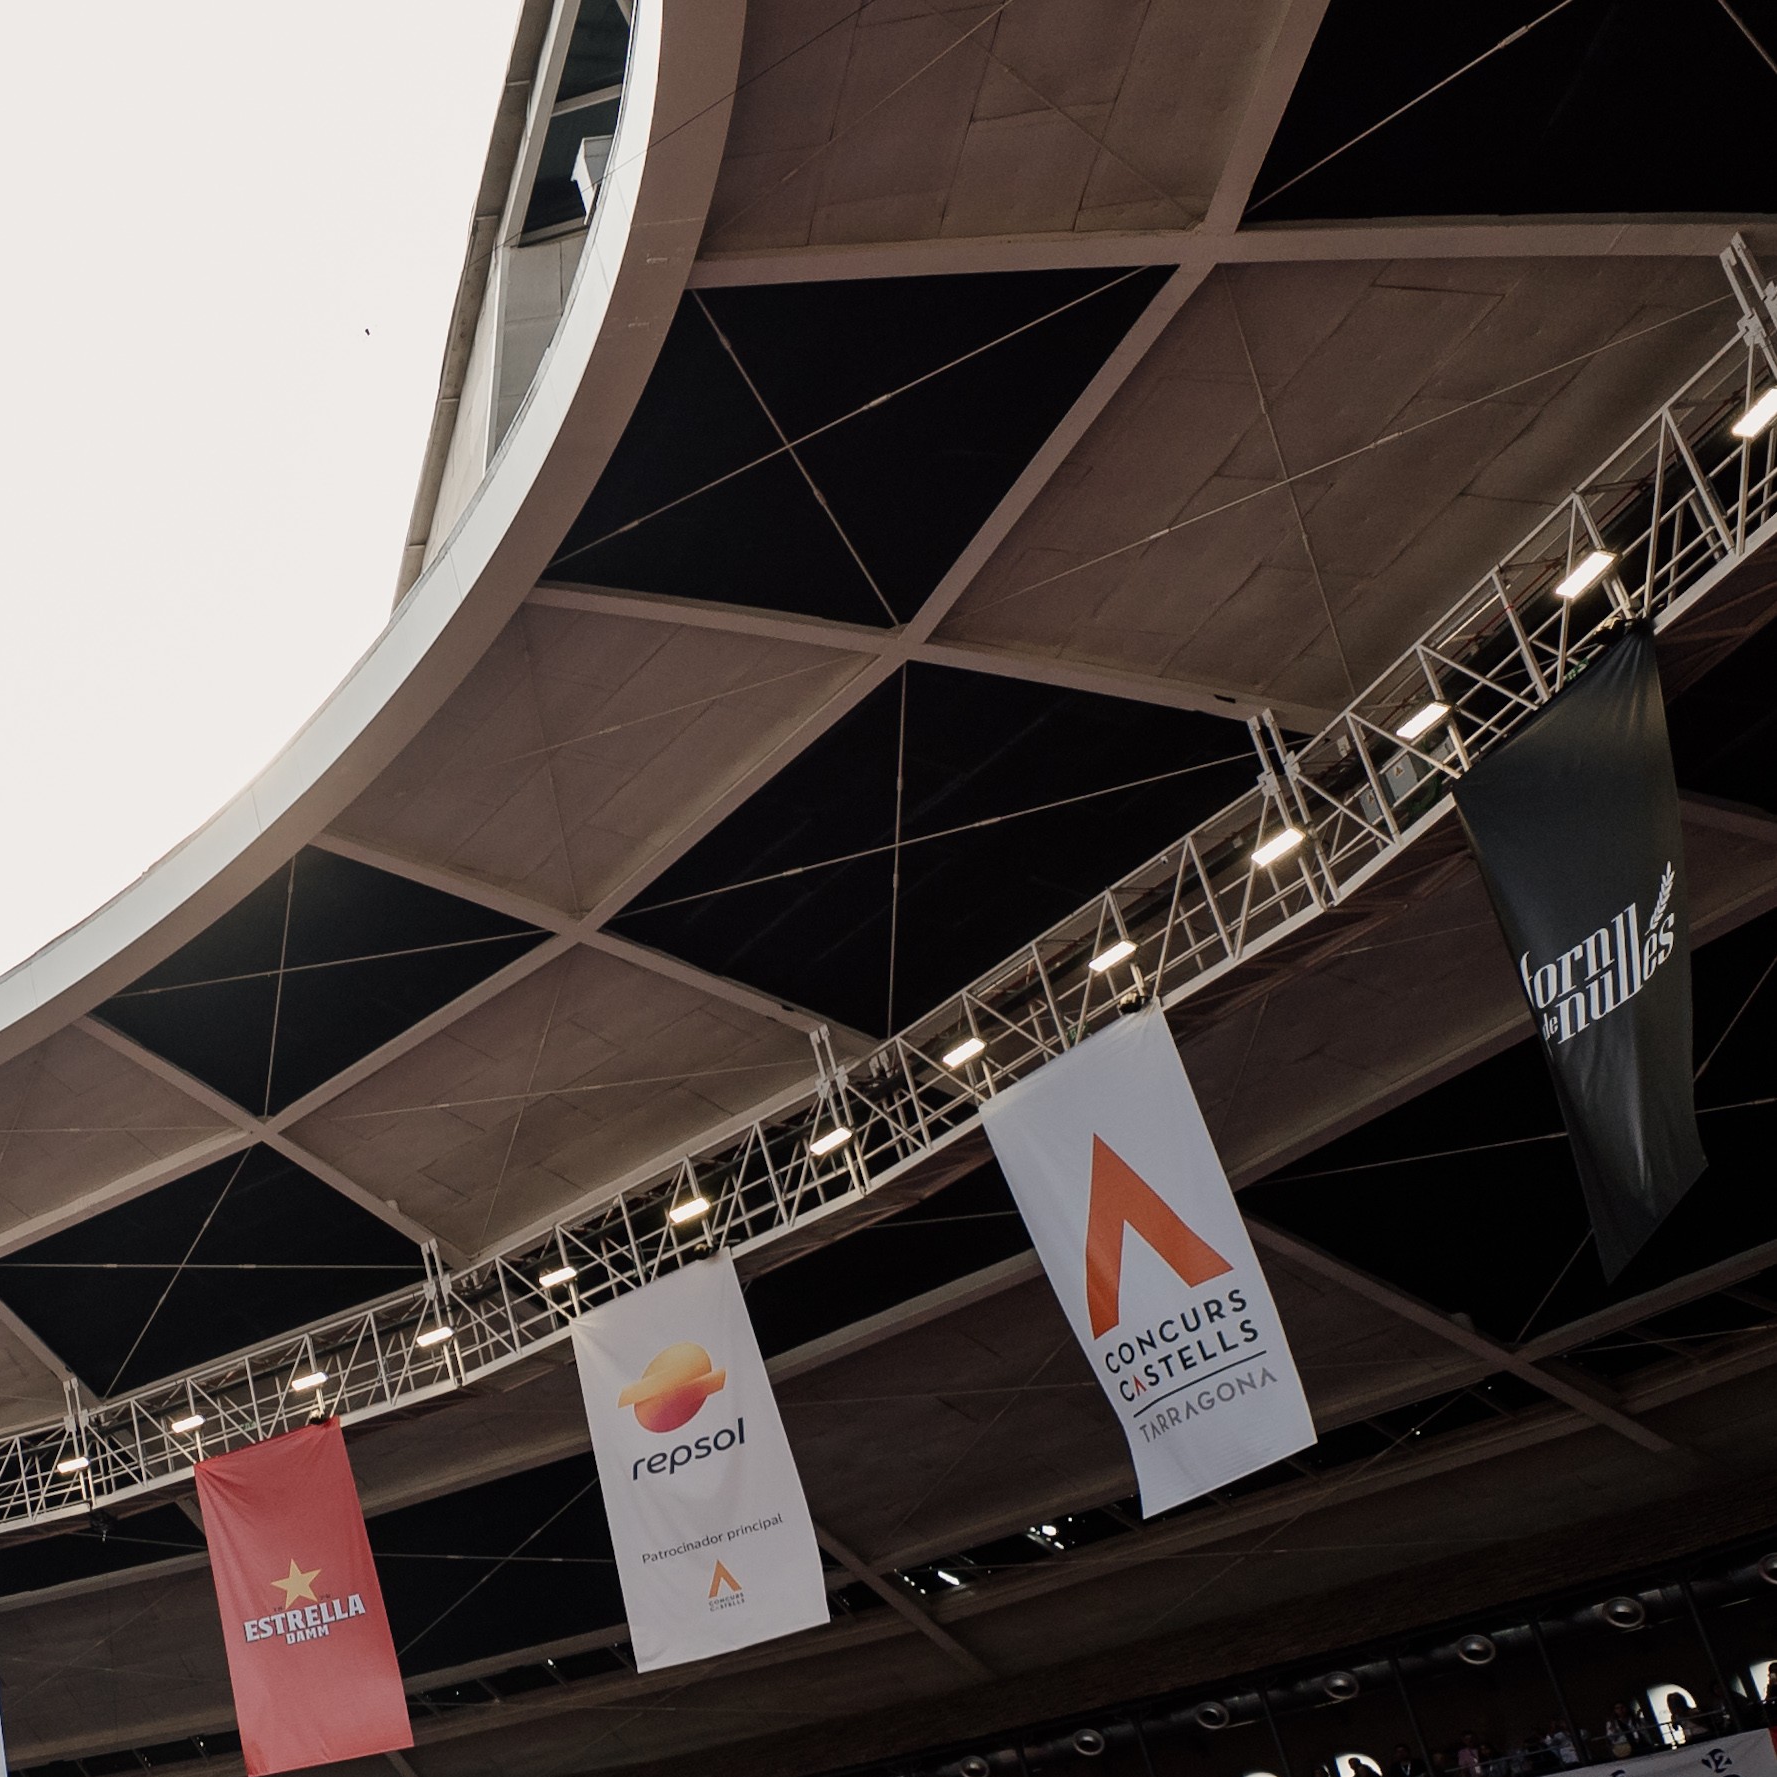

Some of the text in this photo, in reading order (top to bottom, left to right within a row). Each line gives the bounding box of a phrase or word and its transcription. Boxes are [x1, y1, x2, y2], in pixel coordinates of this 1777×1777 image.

[1520, 927, 1615, 1010] forn
[1555, 902, 1675, 1045] nulles
[1105, 1288, 1247, 1374] CONCURS
[1119, 1318, 1259, 1402] CASTELLS
[1140, 1367, 1277, 1444] TARRAGONA
[633, 1417, 746, 1481] repsol
[642, 1513, 784, 1565] Patrocinador principal
[244, 1593, 366, 1642] ESTRELLA
[285, 1624, 330, 1645] DAMM
